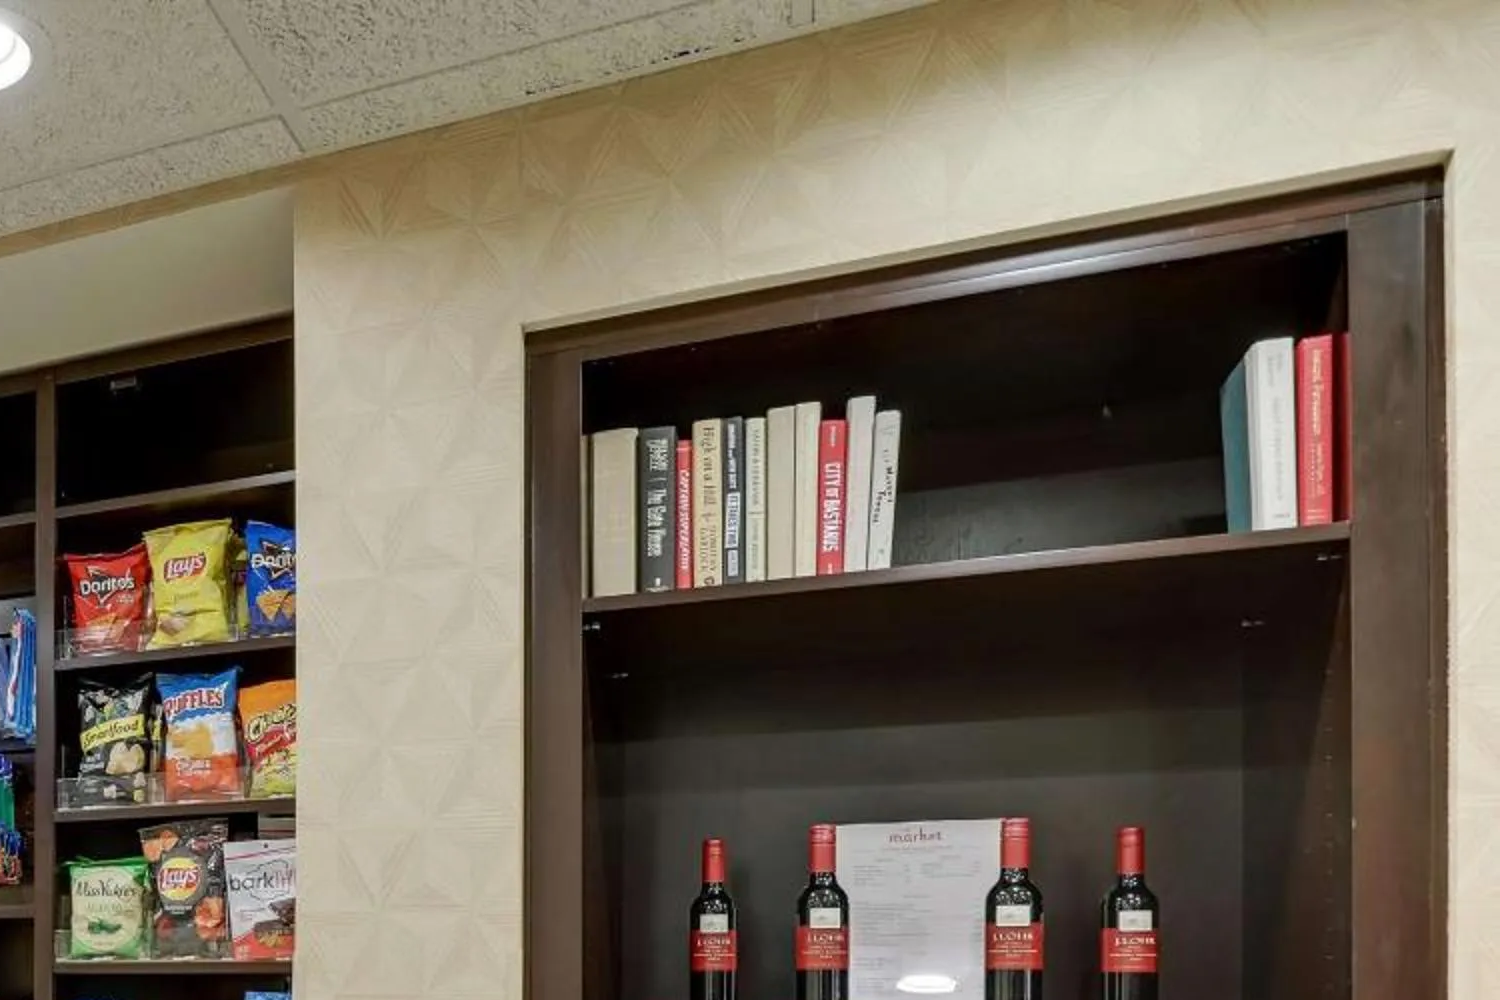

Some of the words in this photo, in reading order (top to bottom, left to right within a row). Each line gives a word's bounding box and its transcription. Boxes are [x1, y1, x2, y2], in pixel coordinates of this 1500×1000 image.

[823, 462, 841, 487] CITY
[165, 554, 205, 581] Lay's
[251, 552, 296, 571] Dorit
[80, 573, 136, 596] Doritos
[75, 880, 102, 898] Miss
[161, 867, 199, 891] Lay's
